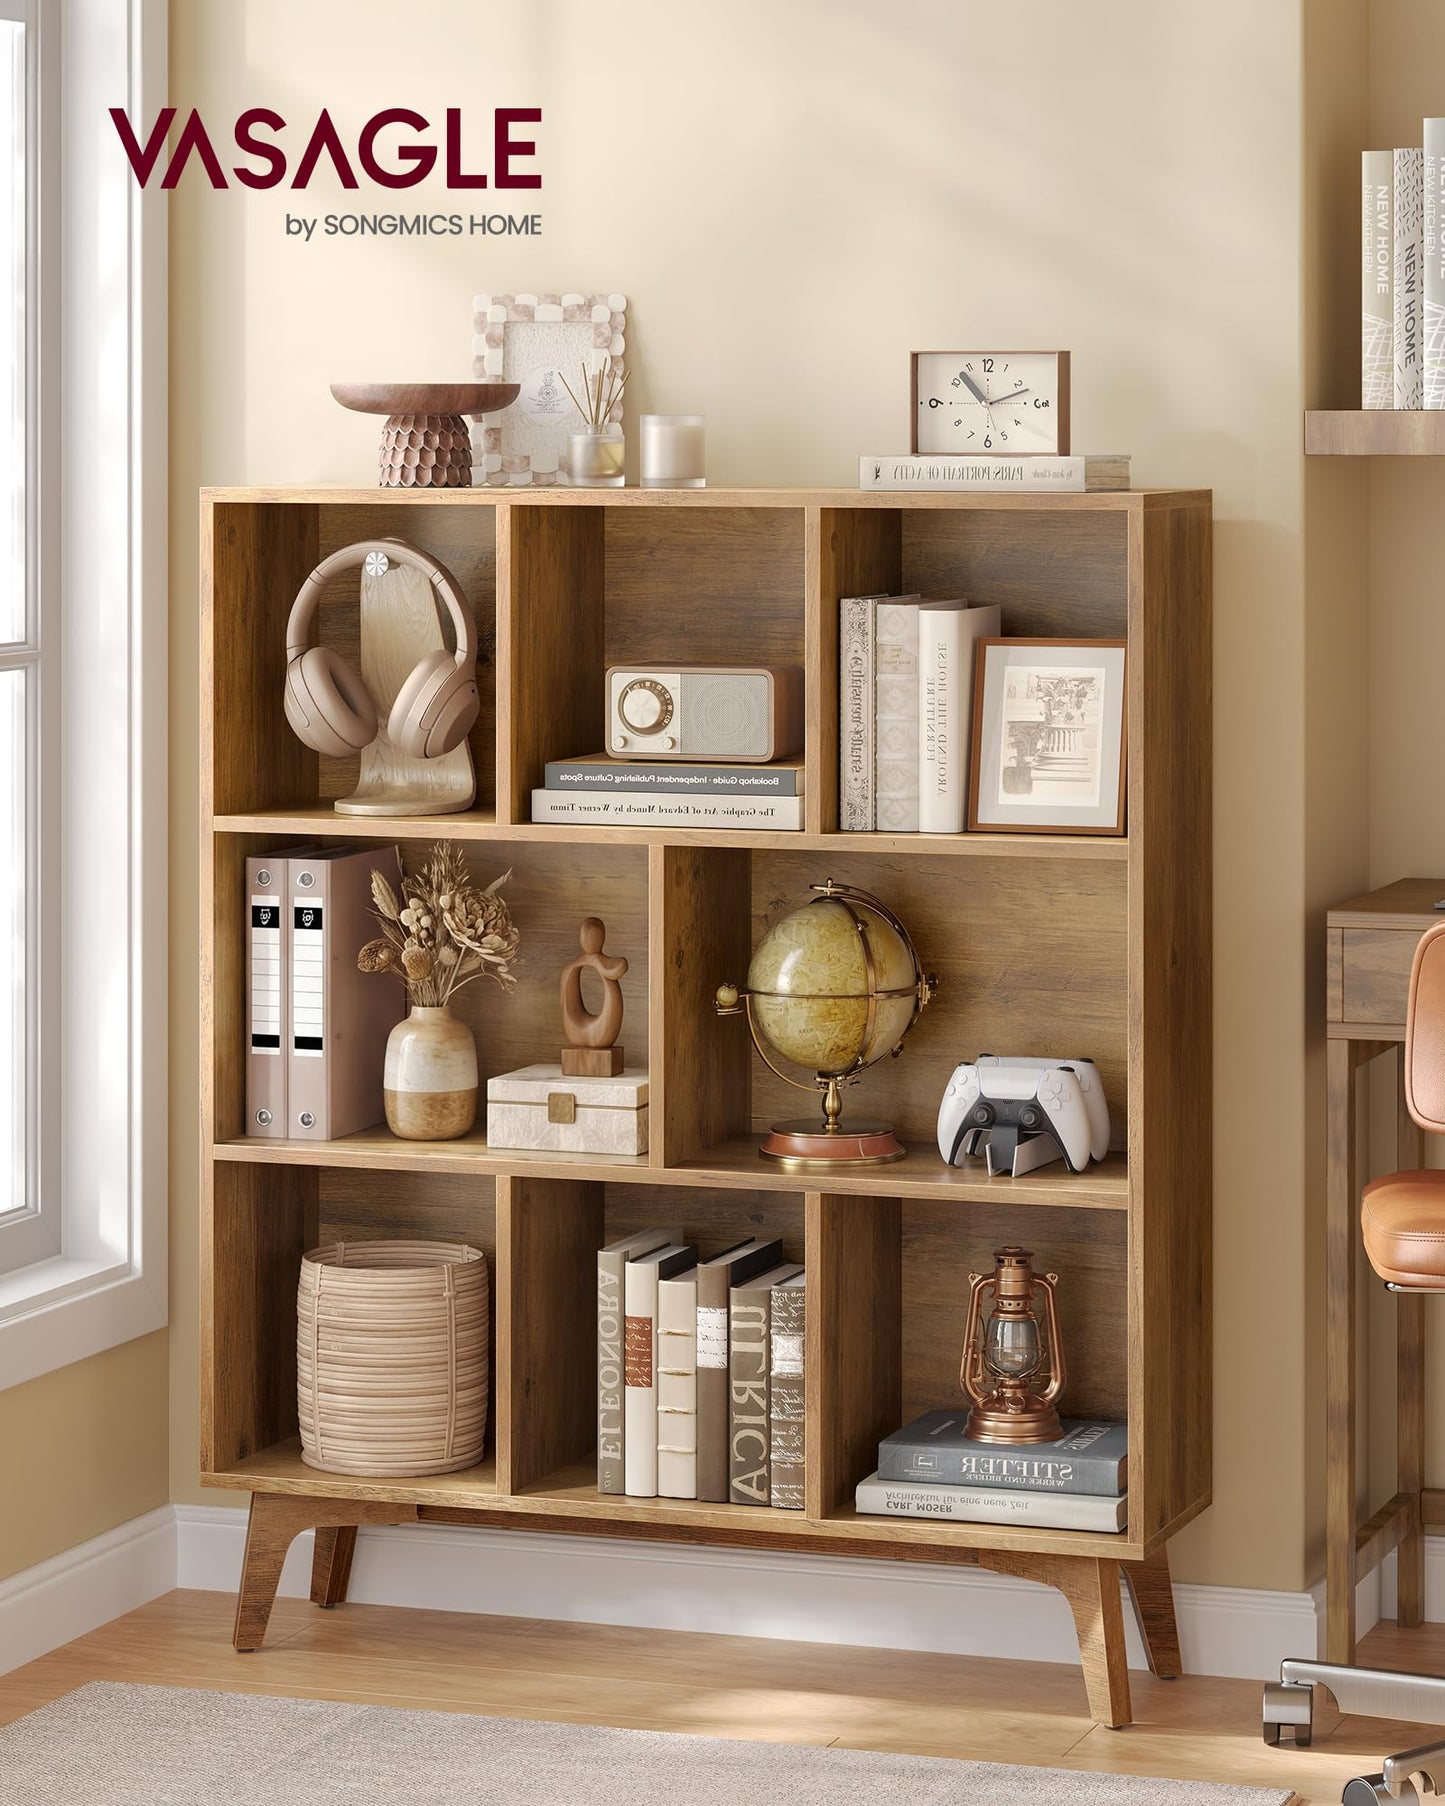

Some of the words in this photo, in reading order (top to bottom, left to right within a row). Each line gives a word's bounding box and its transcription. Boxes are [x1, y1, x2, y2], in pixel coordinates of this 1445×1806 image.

[1426, 155, 1436, 191] NEW
[1364, 184, 1373, 216] NEW
[1376, 184, 1389, 231] NEW
[1426, 194, 1436, 256] KITCHEN
[1364, 218, 1373, 274] KITCHEN
[1376, 236, 1389, 295] HOME
[1404, 243, 1416, 295] NEW
[1404, 301, 1416, 368] HOME
[965, 362, 974, 372] 11
[982, 358, 994, 373] 12
[1003, 363, 1009, 373] 1
[951, 377, 962, 389] 10
[1014, 379, 1023, 388] 2
[953, 418, 963, 427] 8
[1013, 418, 1022, 427] 4
[966, 430, 975, 440] 7
[983, 434, 992, 448] 6
[1000, 431, 1008, 441] 5
